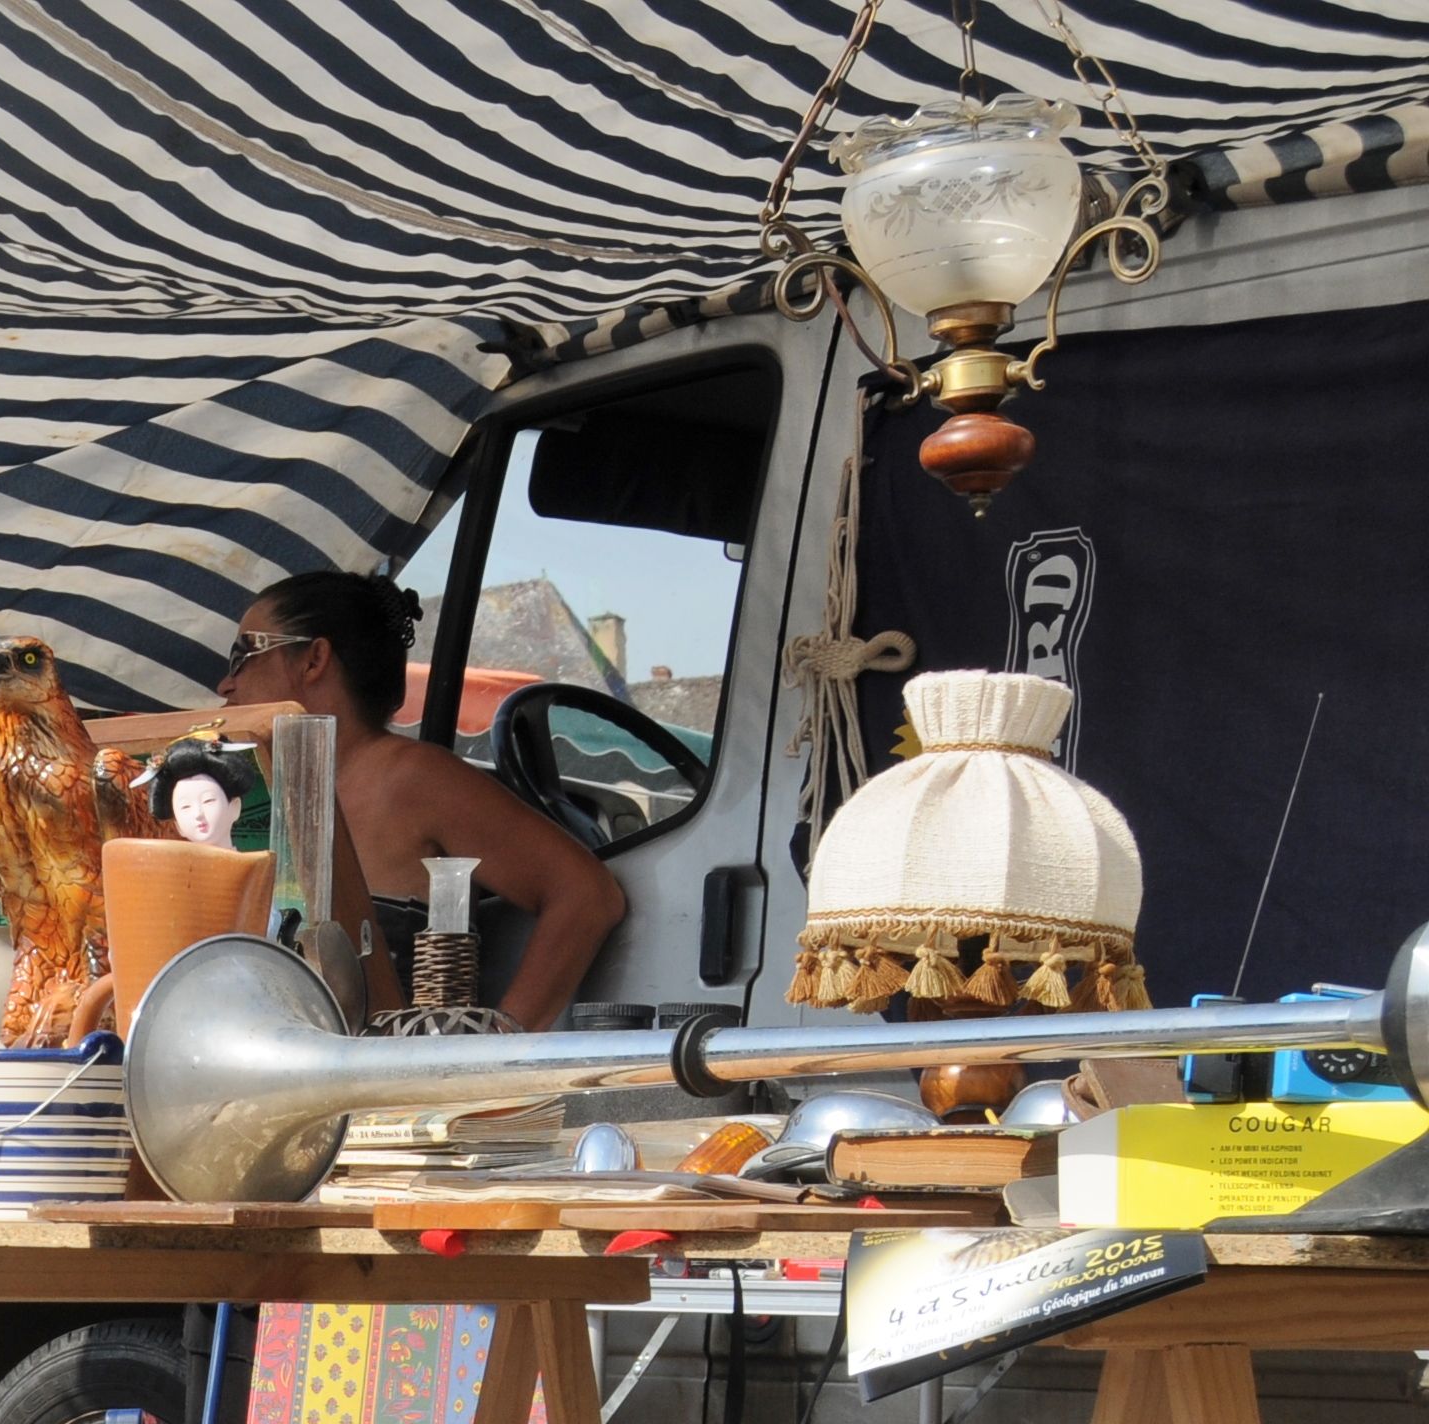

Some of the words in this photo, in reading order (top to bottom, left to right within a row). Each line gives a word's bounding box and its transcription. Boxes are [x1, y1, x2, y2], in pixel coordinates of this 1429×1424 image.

[1228, 1116, 1332, 1133] COUGAR
[1302, 1170, 1333, 1178] CABINET
[889, 1308, 904, 1325] 4
[918, 1298, 941, 1315] et
[979, 1257, 1075, 1296] Juillet
[1084, 1234, 1164, 1268] 2015
[1042, 1284, 1102, 1316] Géologique
[1103, 1279, 1119, 1294] du
[1119, 1267, 1166, 1289] Morvan
